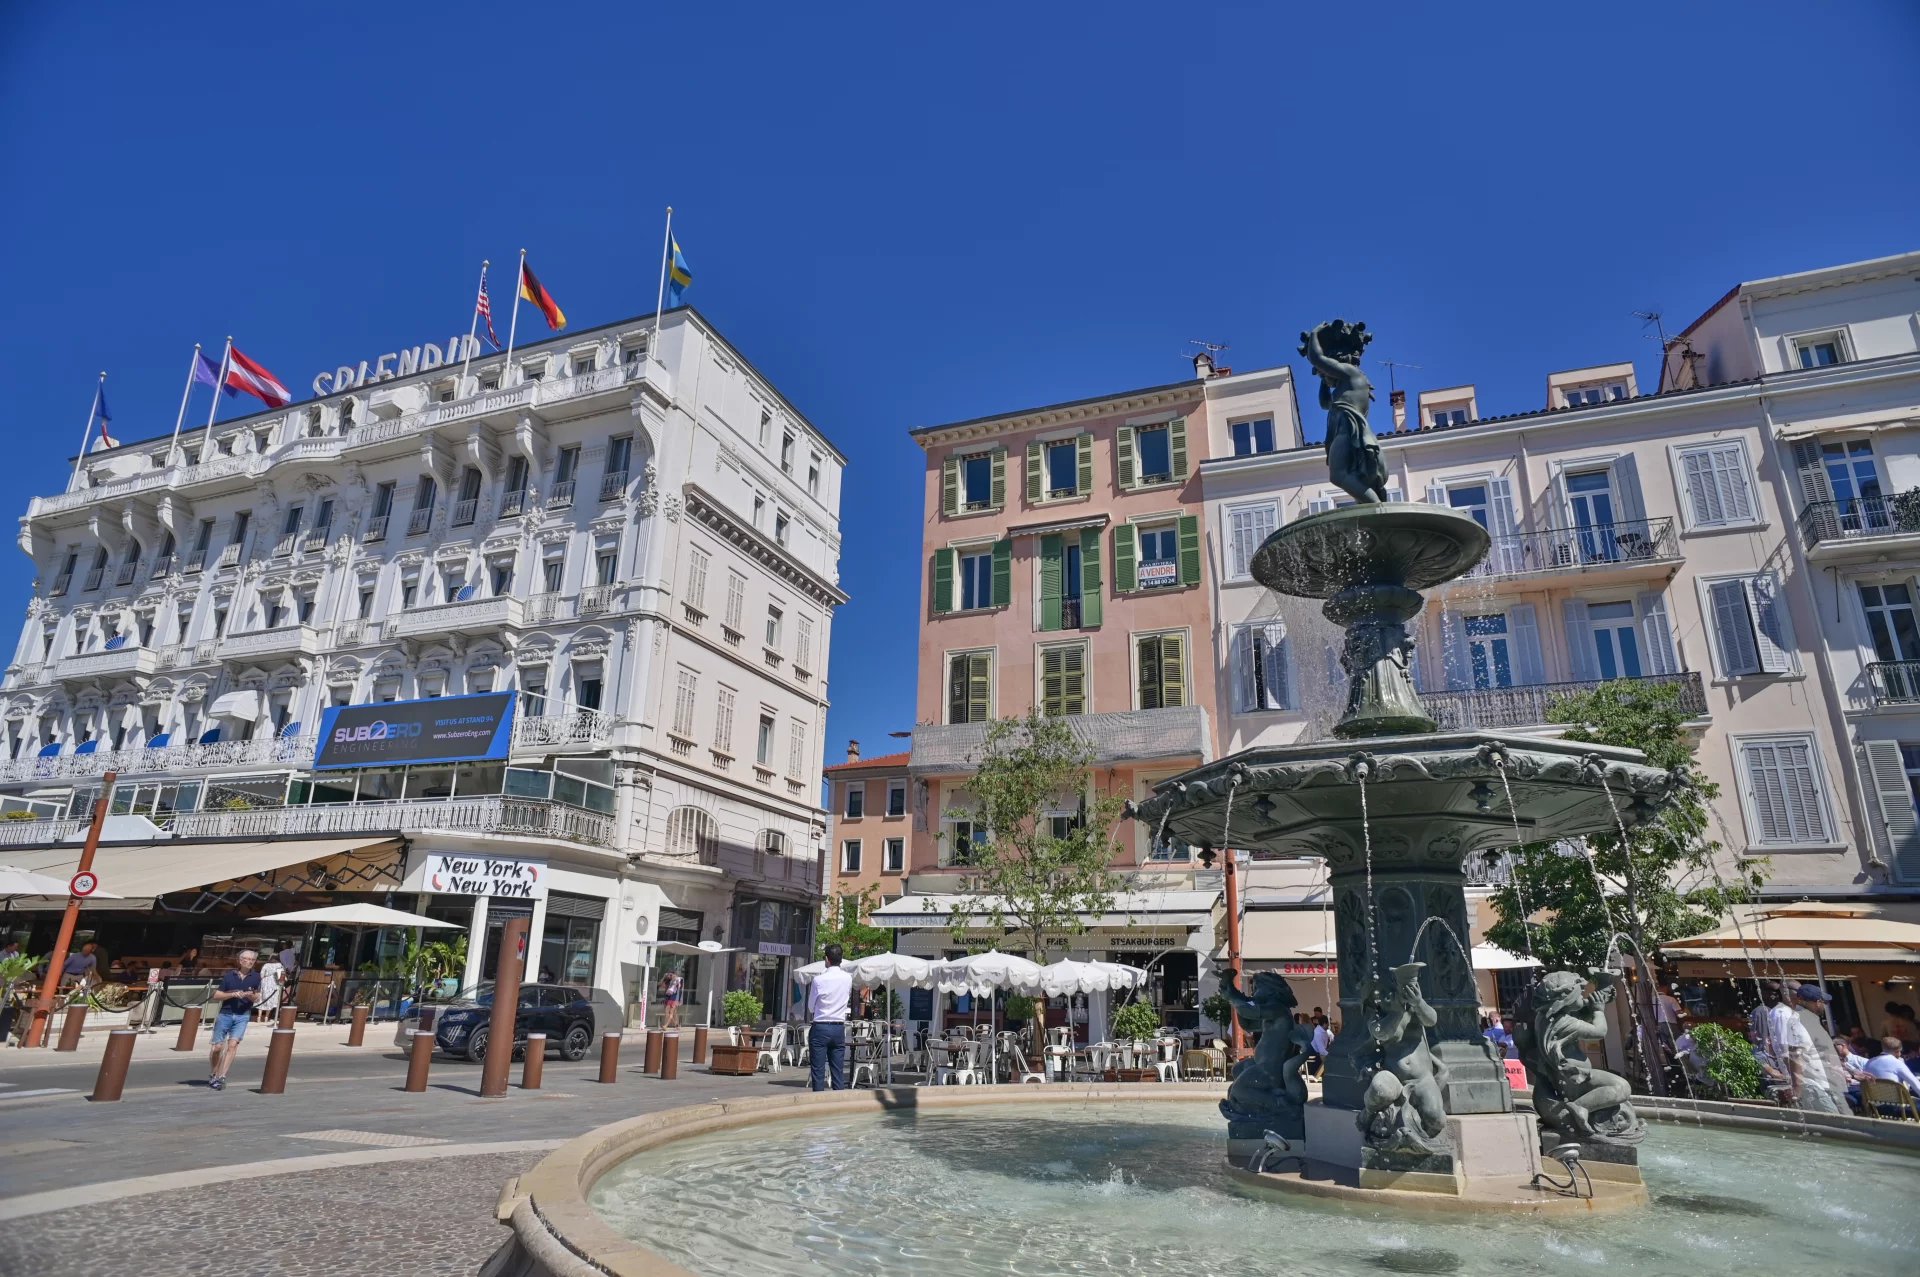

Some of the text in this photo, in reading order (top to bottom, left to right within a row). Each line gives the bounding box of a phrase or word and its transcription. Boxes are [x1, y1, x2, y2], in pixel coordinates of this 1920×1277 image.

[312, 333, 481, 398] SPLENDID
[1146, 566, 1174, 576] VENDRE
[435, 718, 450, 727] VISIT
[450, 717, 458, 725] US
[466, 716, 485, 724] STAND
[334, 720, 423, 743] SUBZERO
[433, 729, 491, 740] www.SubzeroEng.com
[437, 856, 523, 878] New York
[446, 876, 533, 897] New York
[882, 917, 911, 926] STEAK
[920, 916, 949, 926] SHAK
[1046, 937, 1069, 946] FRIES
[1110, 937, 1175, 946] STEAKBURGERS
[1284, 963, 1337, 974] SMASH
